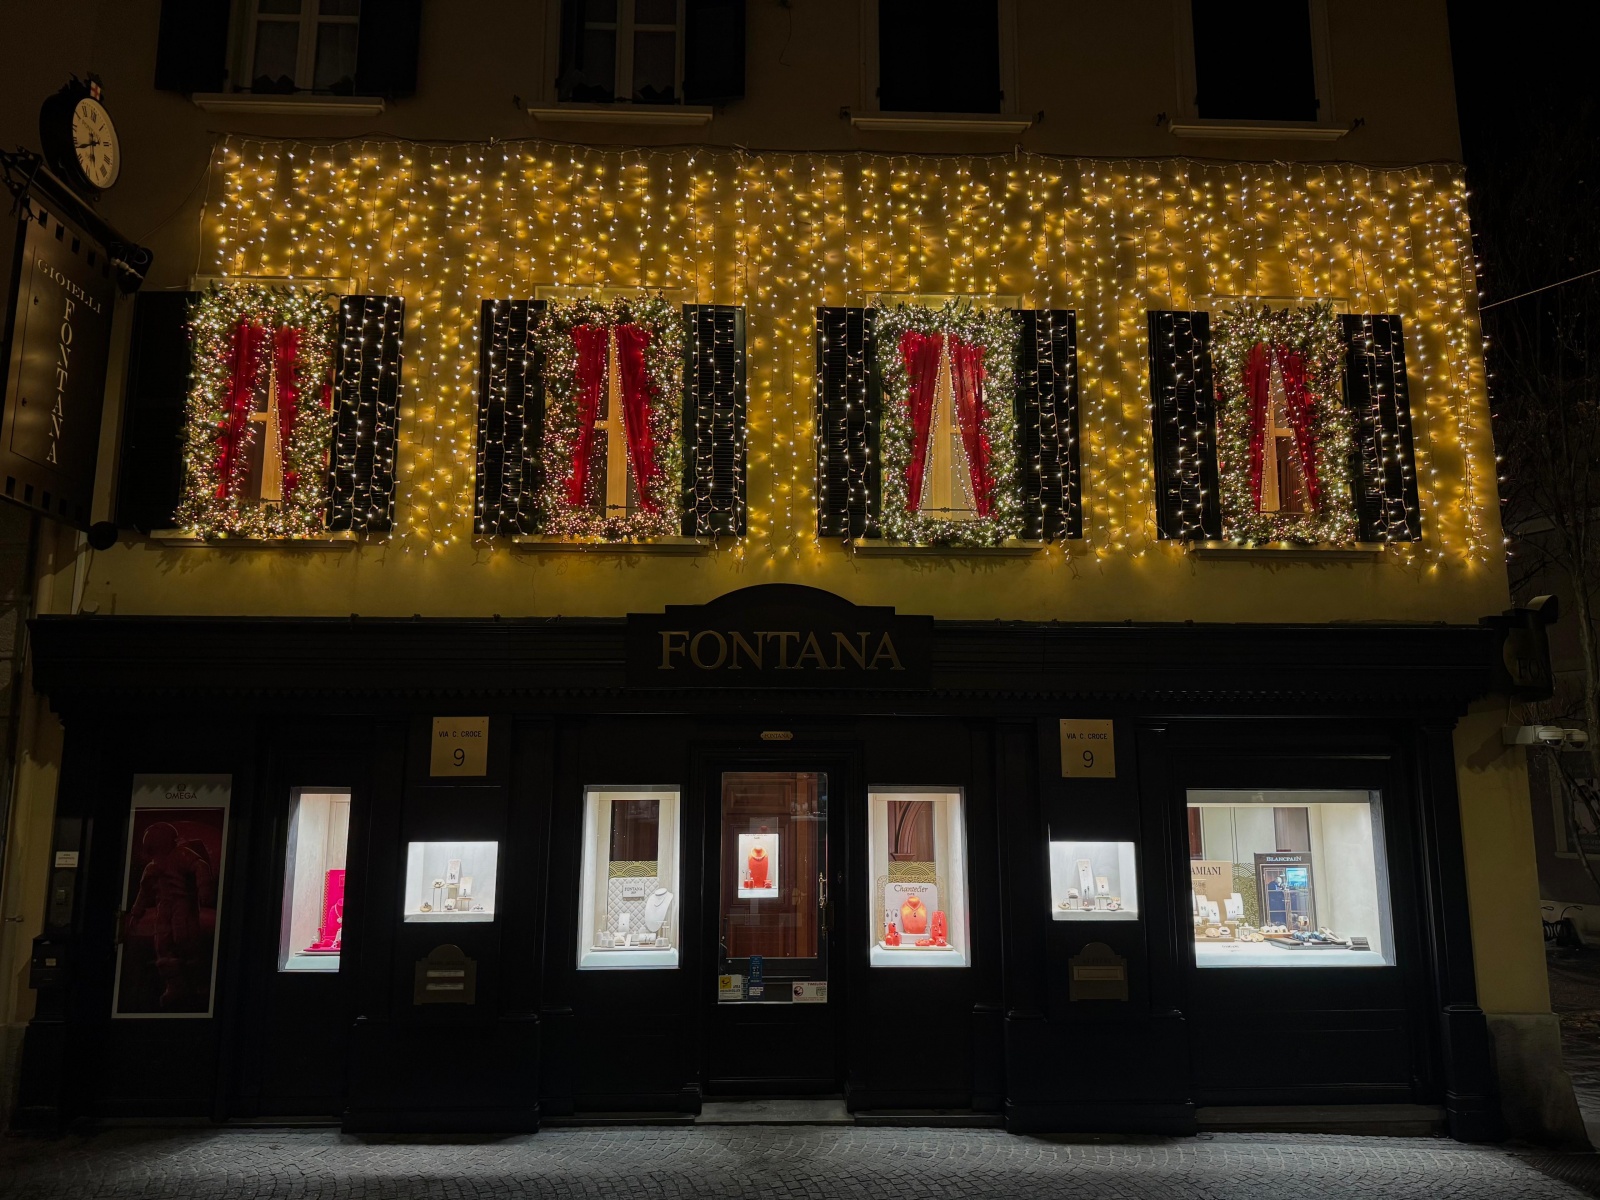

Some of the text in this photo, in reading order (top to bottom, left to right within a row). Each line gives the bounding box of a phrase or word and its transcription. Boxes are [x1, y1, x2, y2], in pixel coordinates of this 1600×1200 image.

[38, 259, 101, 314] GIOIELLI
[46, 298, 76, 465] FONTANA
[657, 630, 906, 671] FONTANA
[438, 730, 449, 738] VIA
[461, 730, 482, 738] CROCE
[1066, 732, 1077, 740] VIA
[1087, 732, 1108, 740] CROCE
[453, 748, 466, 768] 9
[1082, 750, 1095, 768] 9
[165, 792, 197, 800] OMEGA
